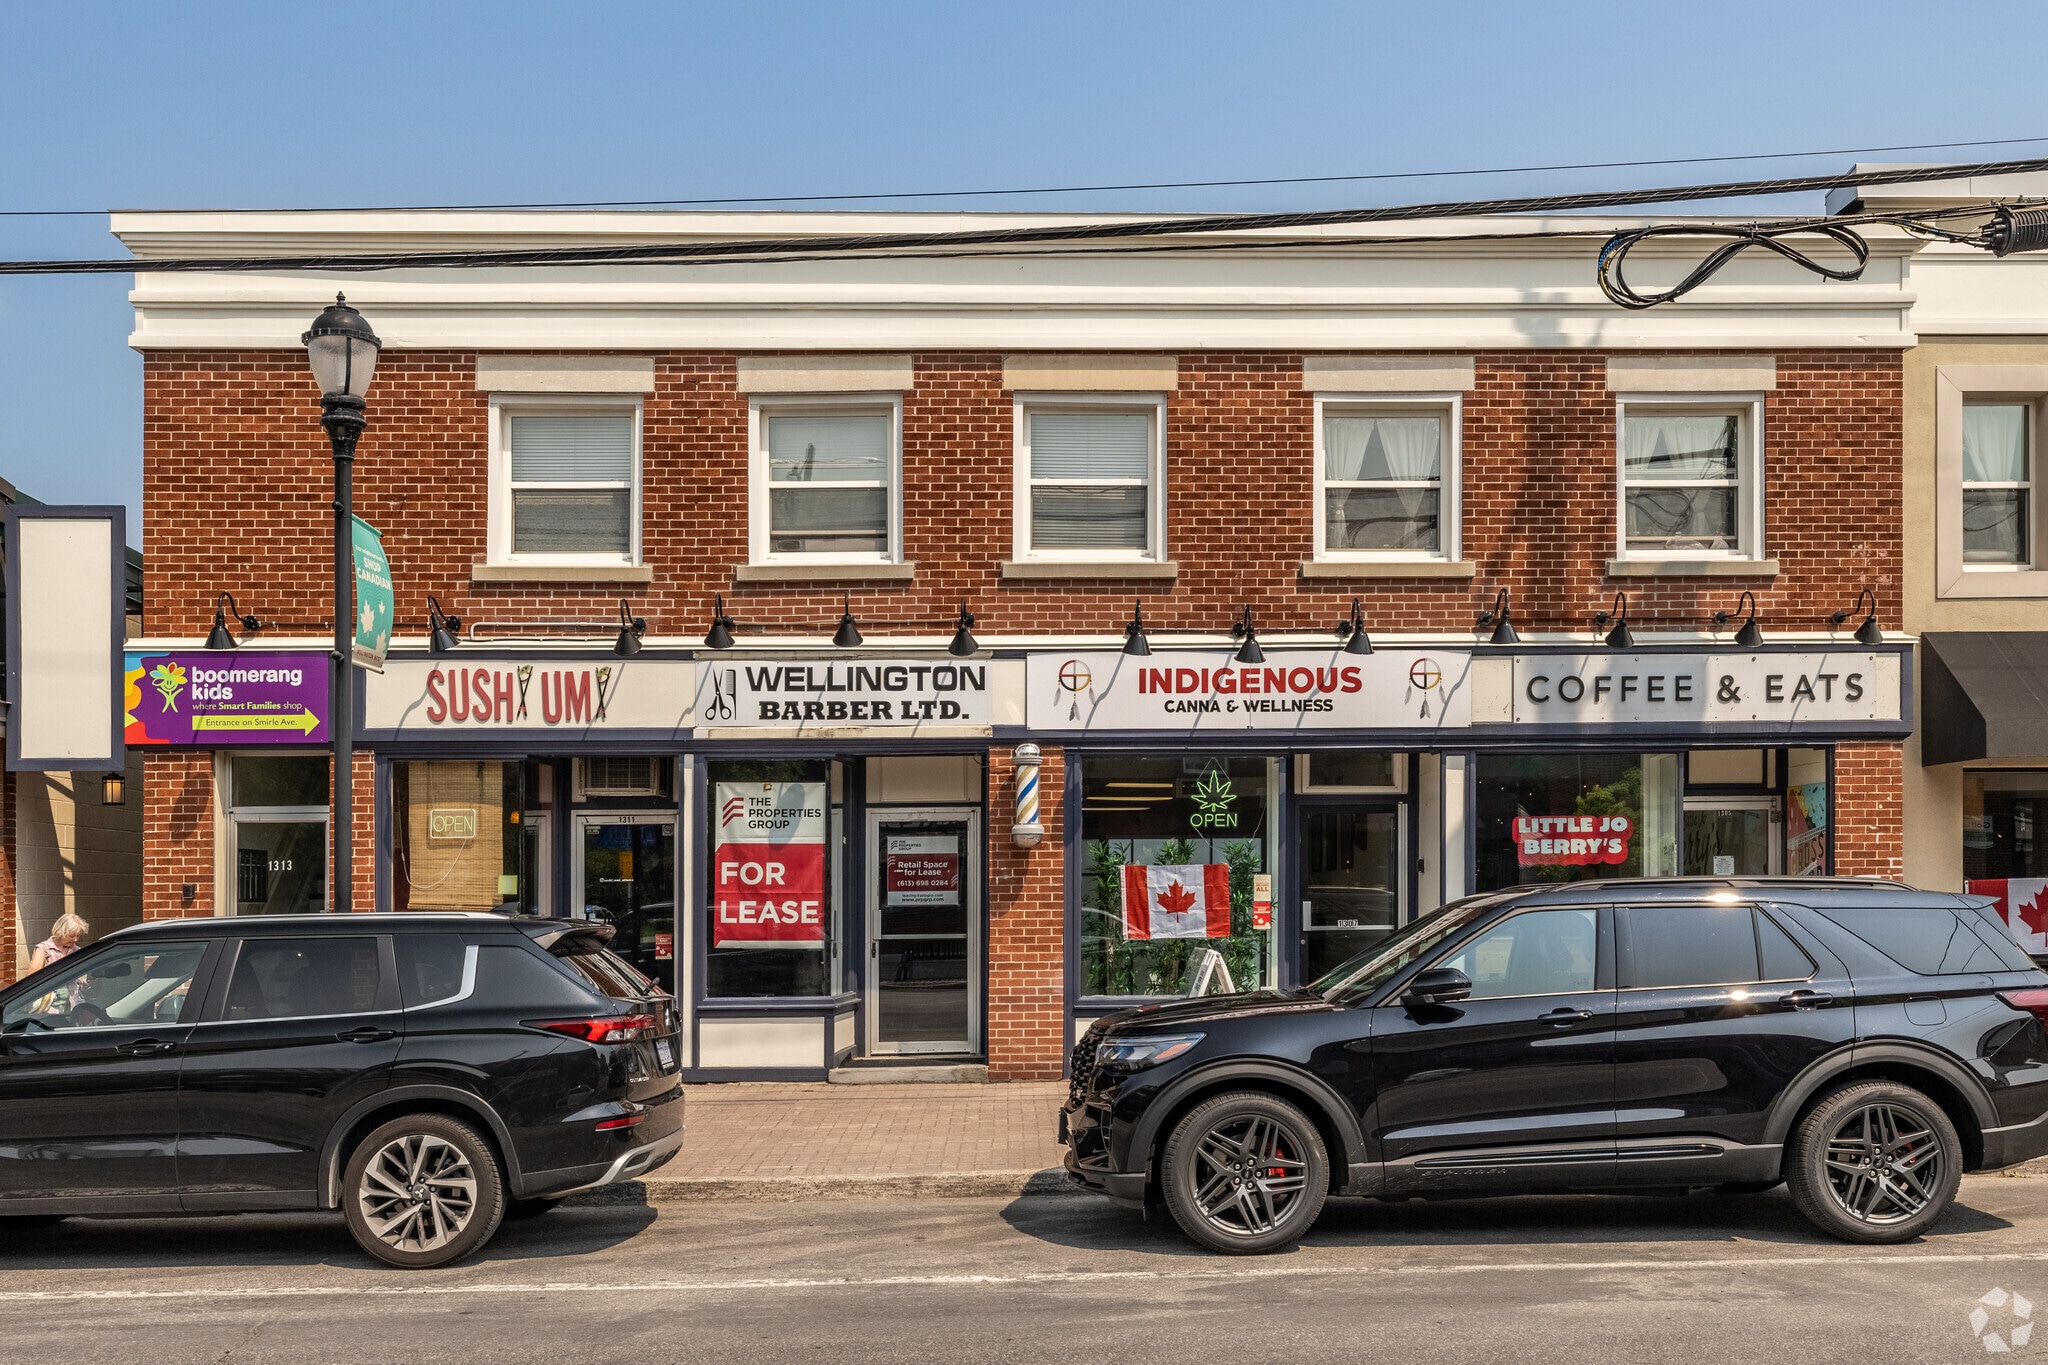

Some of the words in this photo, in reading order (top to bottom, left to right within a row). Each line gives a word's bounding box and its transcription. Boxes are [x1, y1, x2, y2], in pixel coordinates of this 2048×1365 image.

[363, 556, 381, 573] SHOP
[356, 566, 392, 590] CANADIAN
[192, 666, 302, 686] boomerang
[745, 666, 986, 691] WELLINGTON
[1138, 666, 1363, 694] INDIGENOUS
[192, 683, 233, 700] kids
[1526, 675, 1693, 702] COFFEE
[1716, 674, 1741, 702] &
[1766, 673, 1863, 702] EATS
[192, 701, 217, 710] where
[218, 702, 245, 710] Smart
[246, 701, 281, 710] Families
[282, 701, 302, 712] shop
[758, 700, 893, 720] BARBER
[900, 700, 970, 720] LTD.
[1164, 700, 1221, 713] CANNA
[1226, 700, 1239, 713] &
[1243, 699, 1334, 713] WELLNESS
[206, 718, 240, 727] Entrance
[254, 717, 279, 726] Smirle
[280, 717, 298, 726] Ave.
[748, 797, 771, 806] THE
[748, 809, 821, 818] PROPERTIES
[1190, 813, 1238, 827] OPEN
[433, 815, 473, 832] OPEN
[748, 820, 790, 829] GROUP
[1518, 817, 1594, 833] LITTLE
[1599, 816, 1628, 832] JO
[1524, 838, 1623, 855] BERRY'S
[268, 860, 293, 871] 1313
[720, 862, 786, 885] FOR
[923, 861, 948, 870] Space
[720, 900, 819, 924] LEASE
